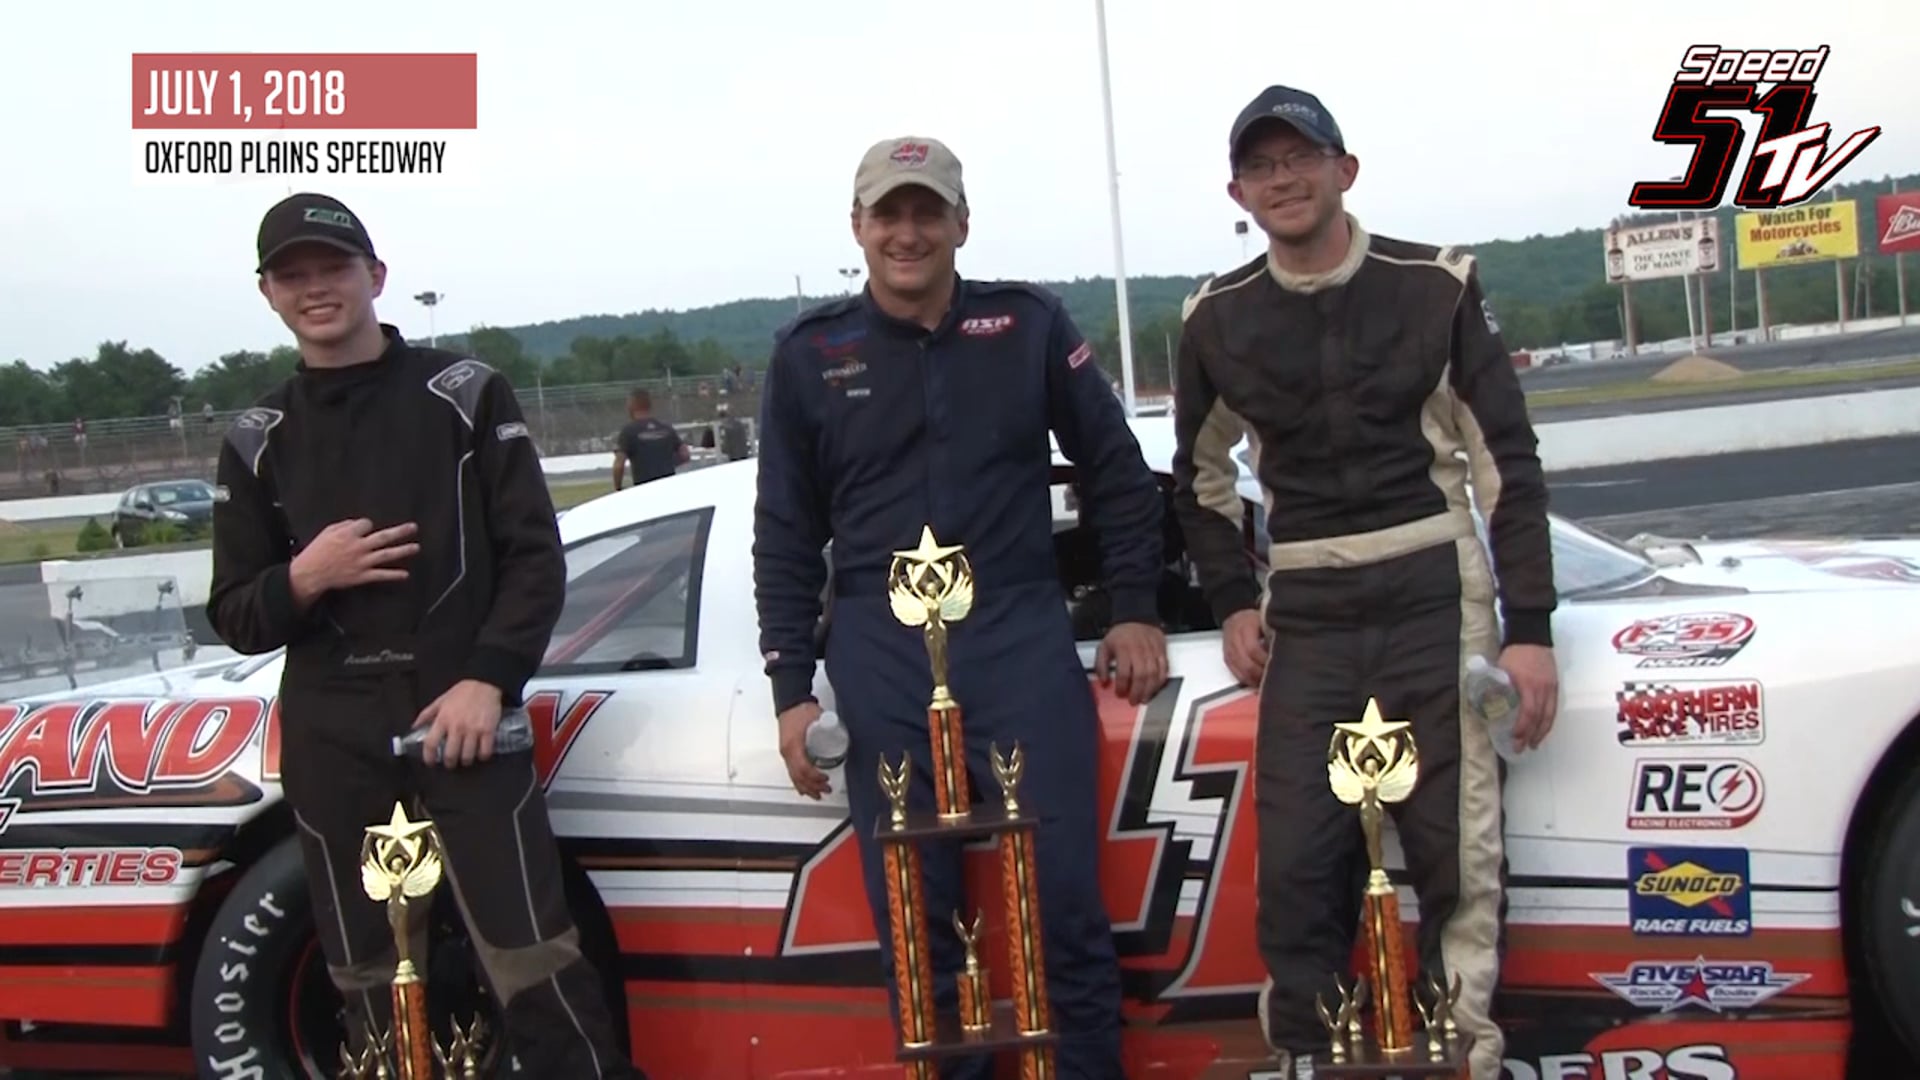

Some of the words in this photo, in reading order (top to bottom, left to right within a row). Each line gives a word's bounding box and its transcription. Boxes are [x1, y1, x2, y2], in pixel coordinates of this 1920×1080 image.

[1758, 208, 1806, 227] Watch
[1808, 206, 1831, 219] For
[1750, 220, 1842, 242] Motorcycles
[1619, 683, 1758, 718] NORTHERN
[1698, 711, 1759, 734] TIRES
[1640, 876, 1738, 893] SUNOCO
[1633, 919, 1685, 933] RACE
[1689, 919, 1749, 933] FUELS
[1630, 965, 1694, 985] FIVE
[1702, 965, 1768, 985] STAR
